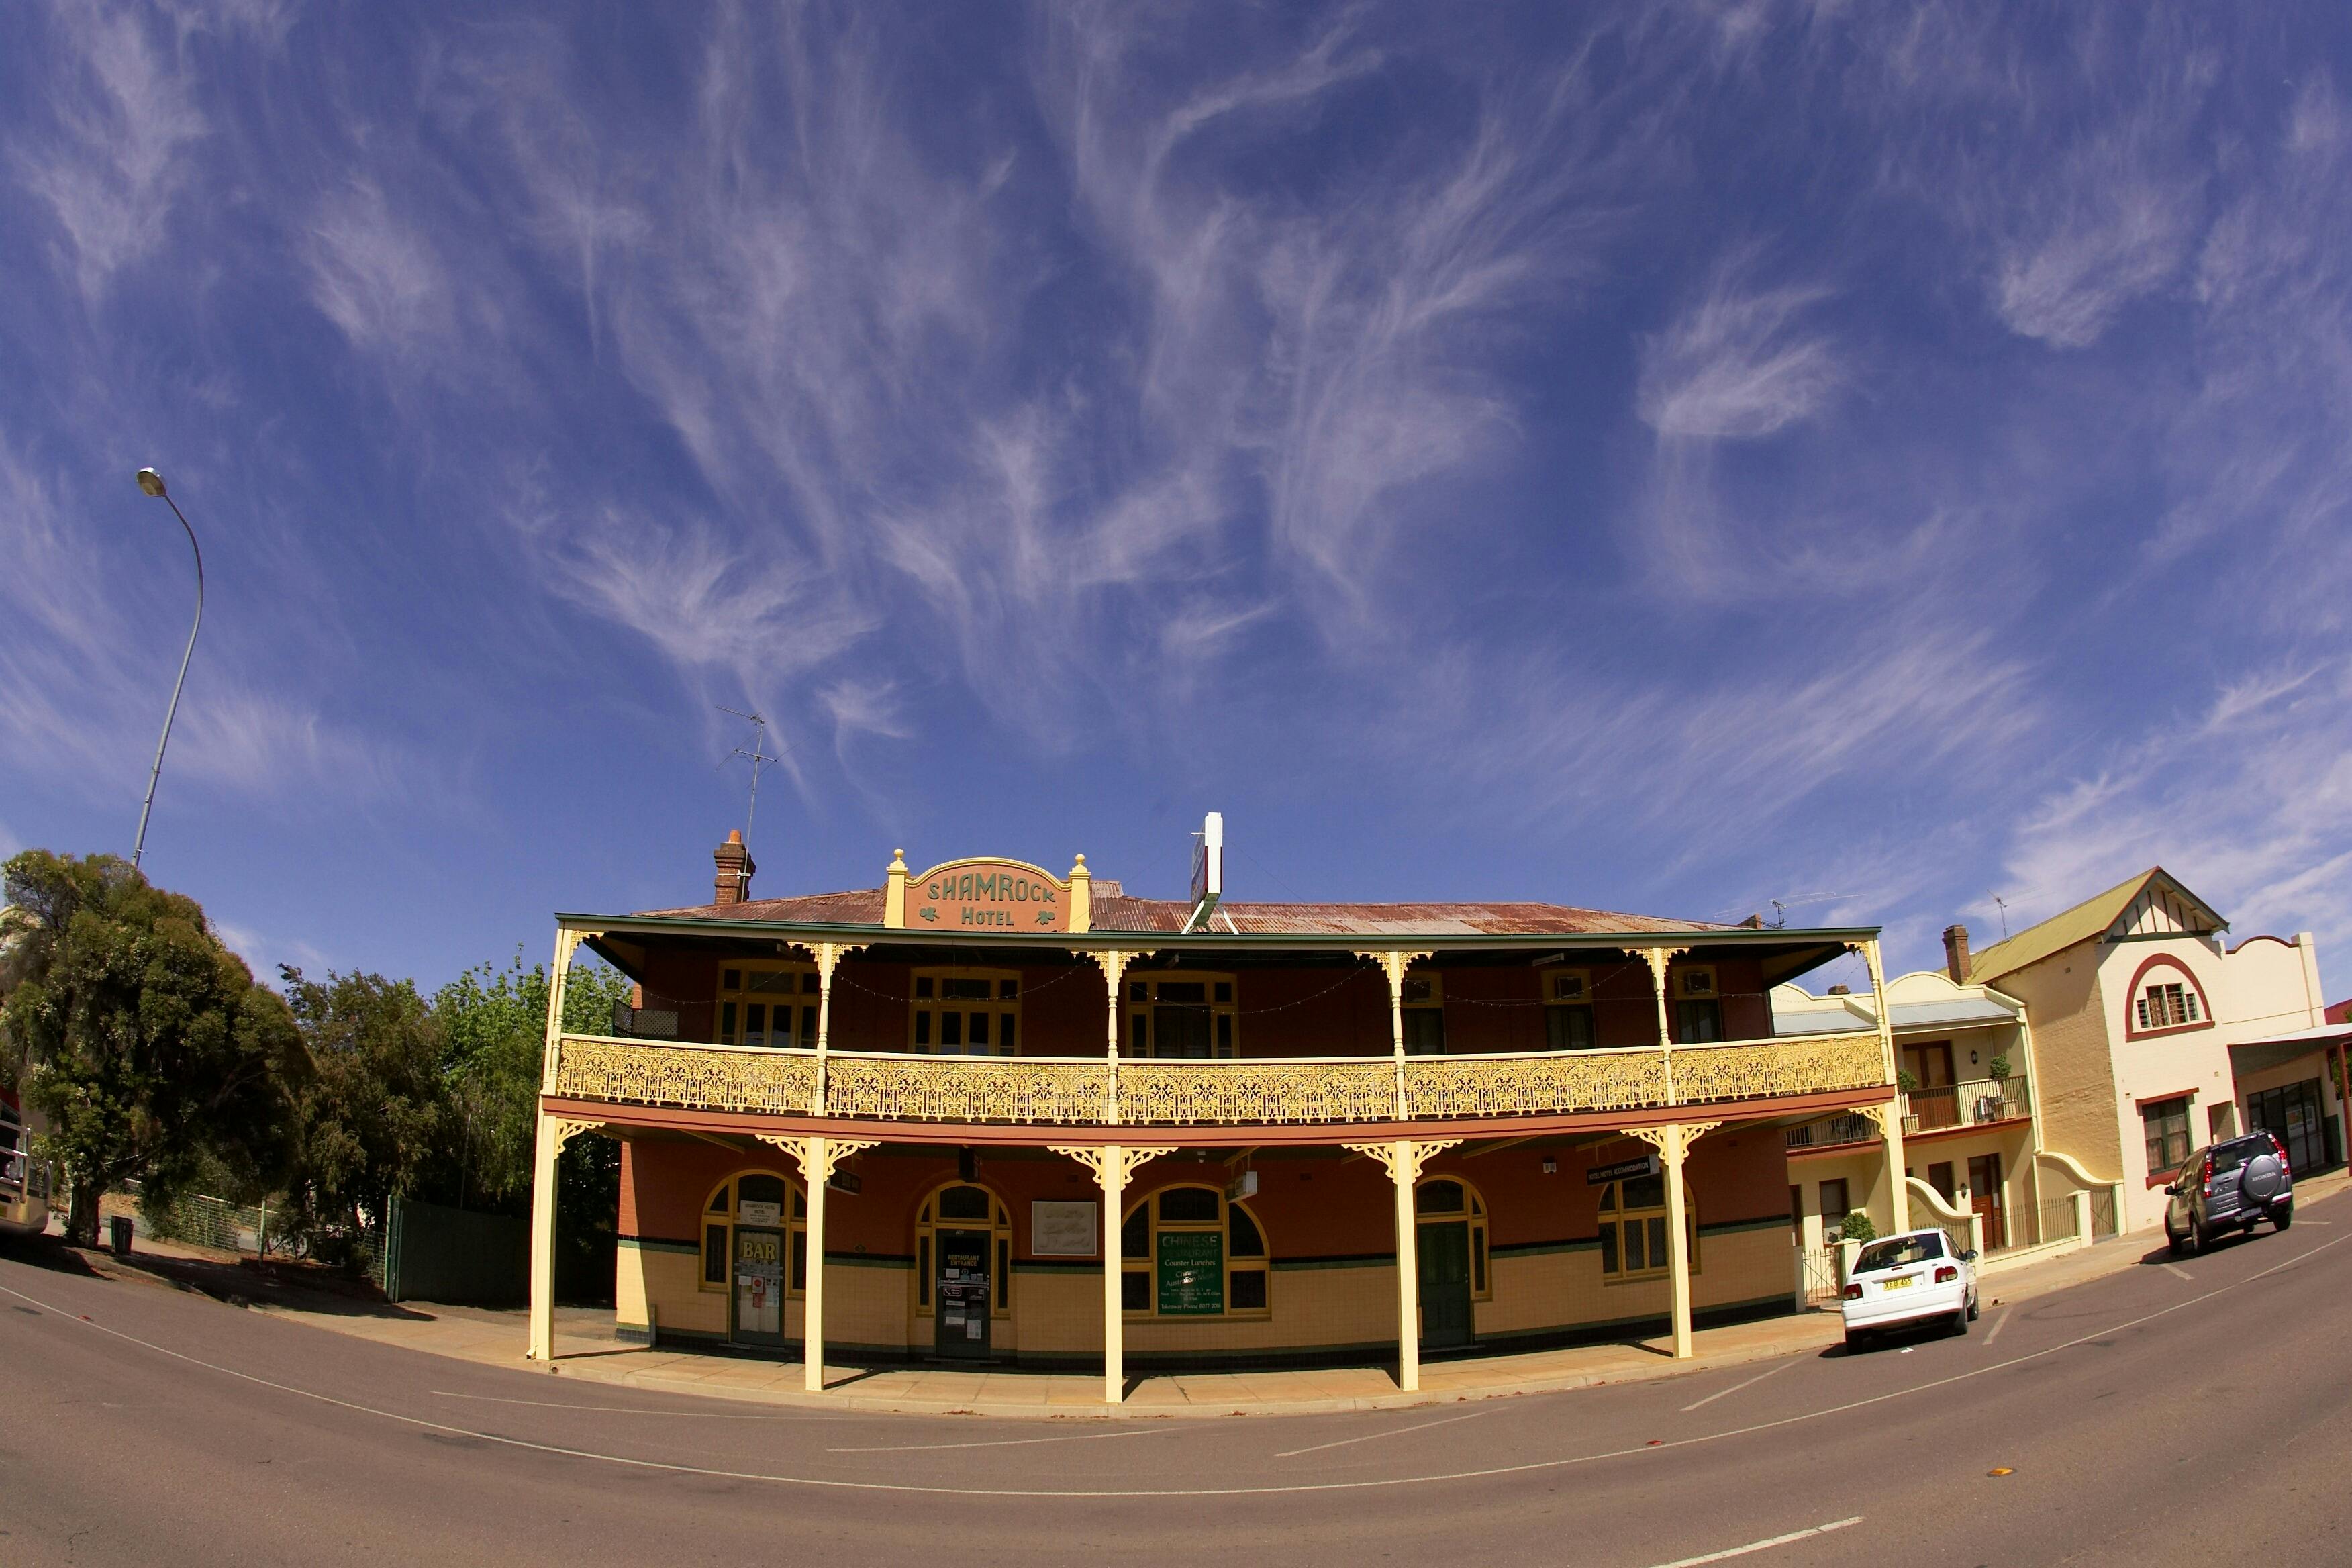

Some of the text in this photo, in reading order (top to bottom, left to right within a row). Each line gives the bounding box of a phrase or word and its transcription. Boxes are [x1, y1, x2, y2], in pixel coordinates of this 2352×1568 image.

[927, 873, 1056, 903] SHAMROCK
[961, 906, 1015, 926] HOTEL
[2251, 1171, 2277, 1182] HONDA
[743, 1241, 776, 1260] BAR
[1165, 1259, 1216, 1267] Counter Lunches
